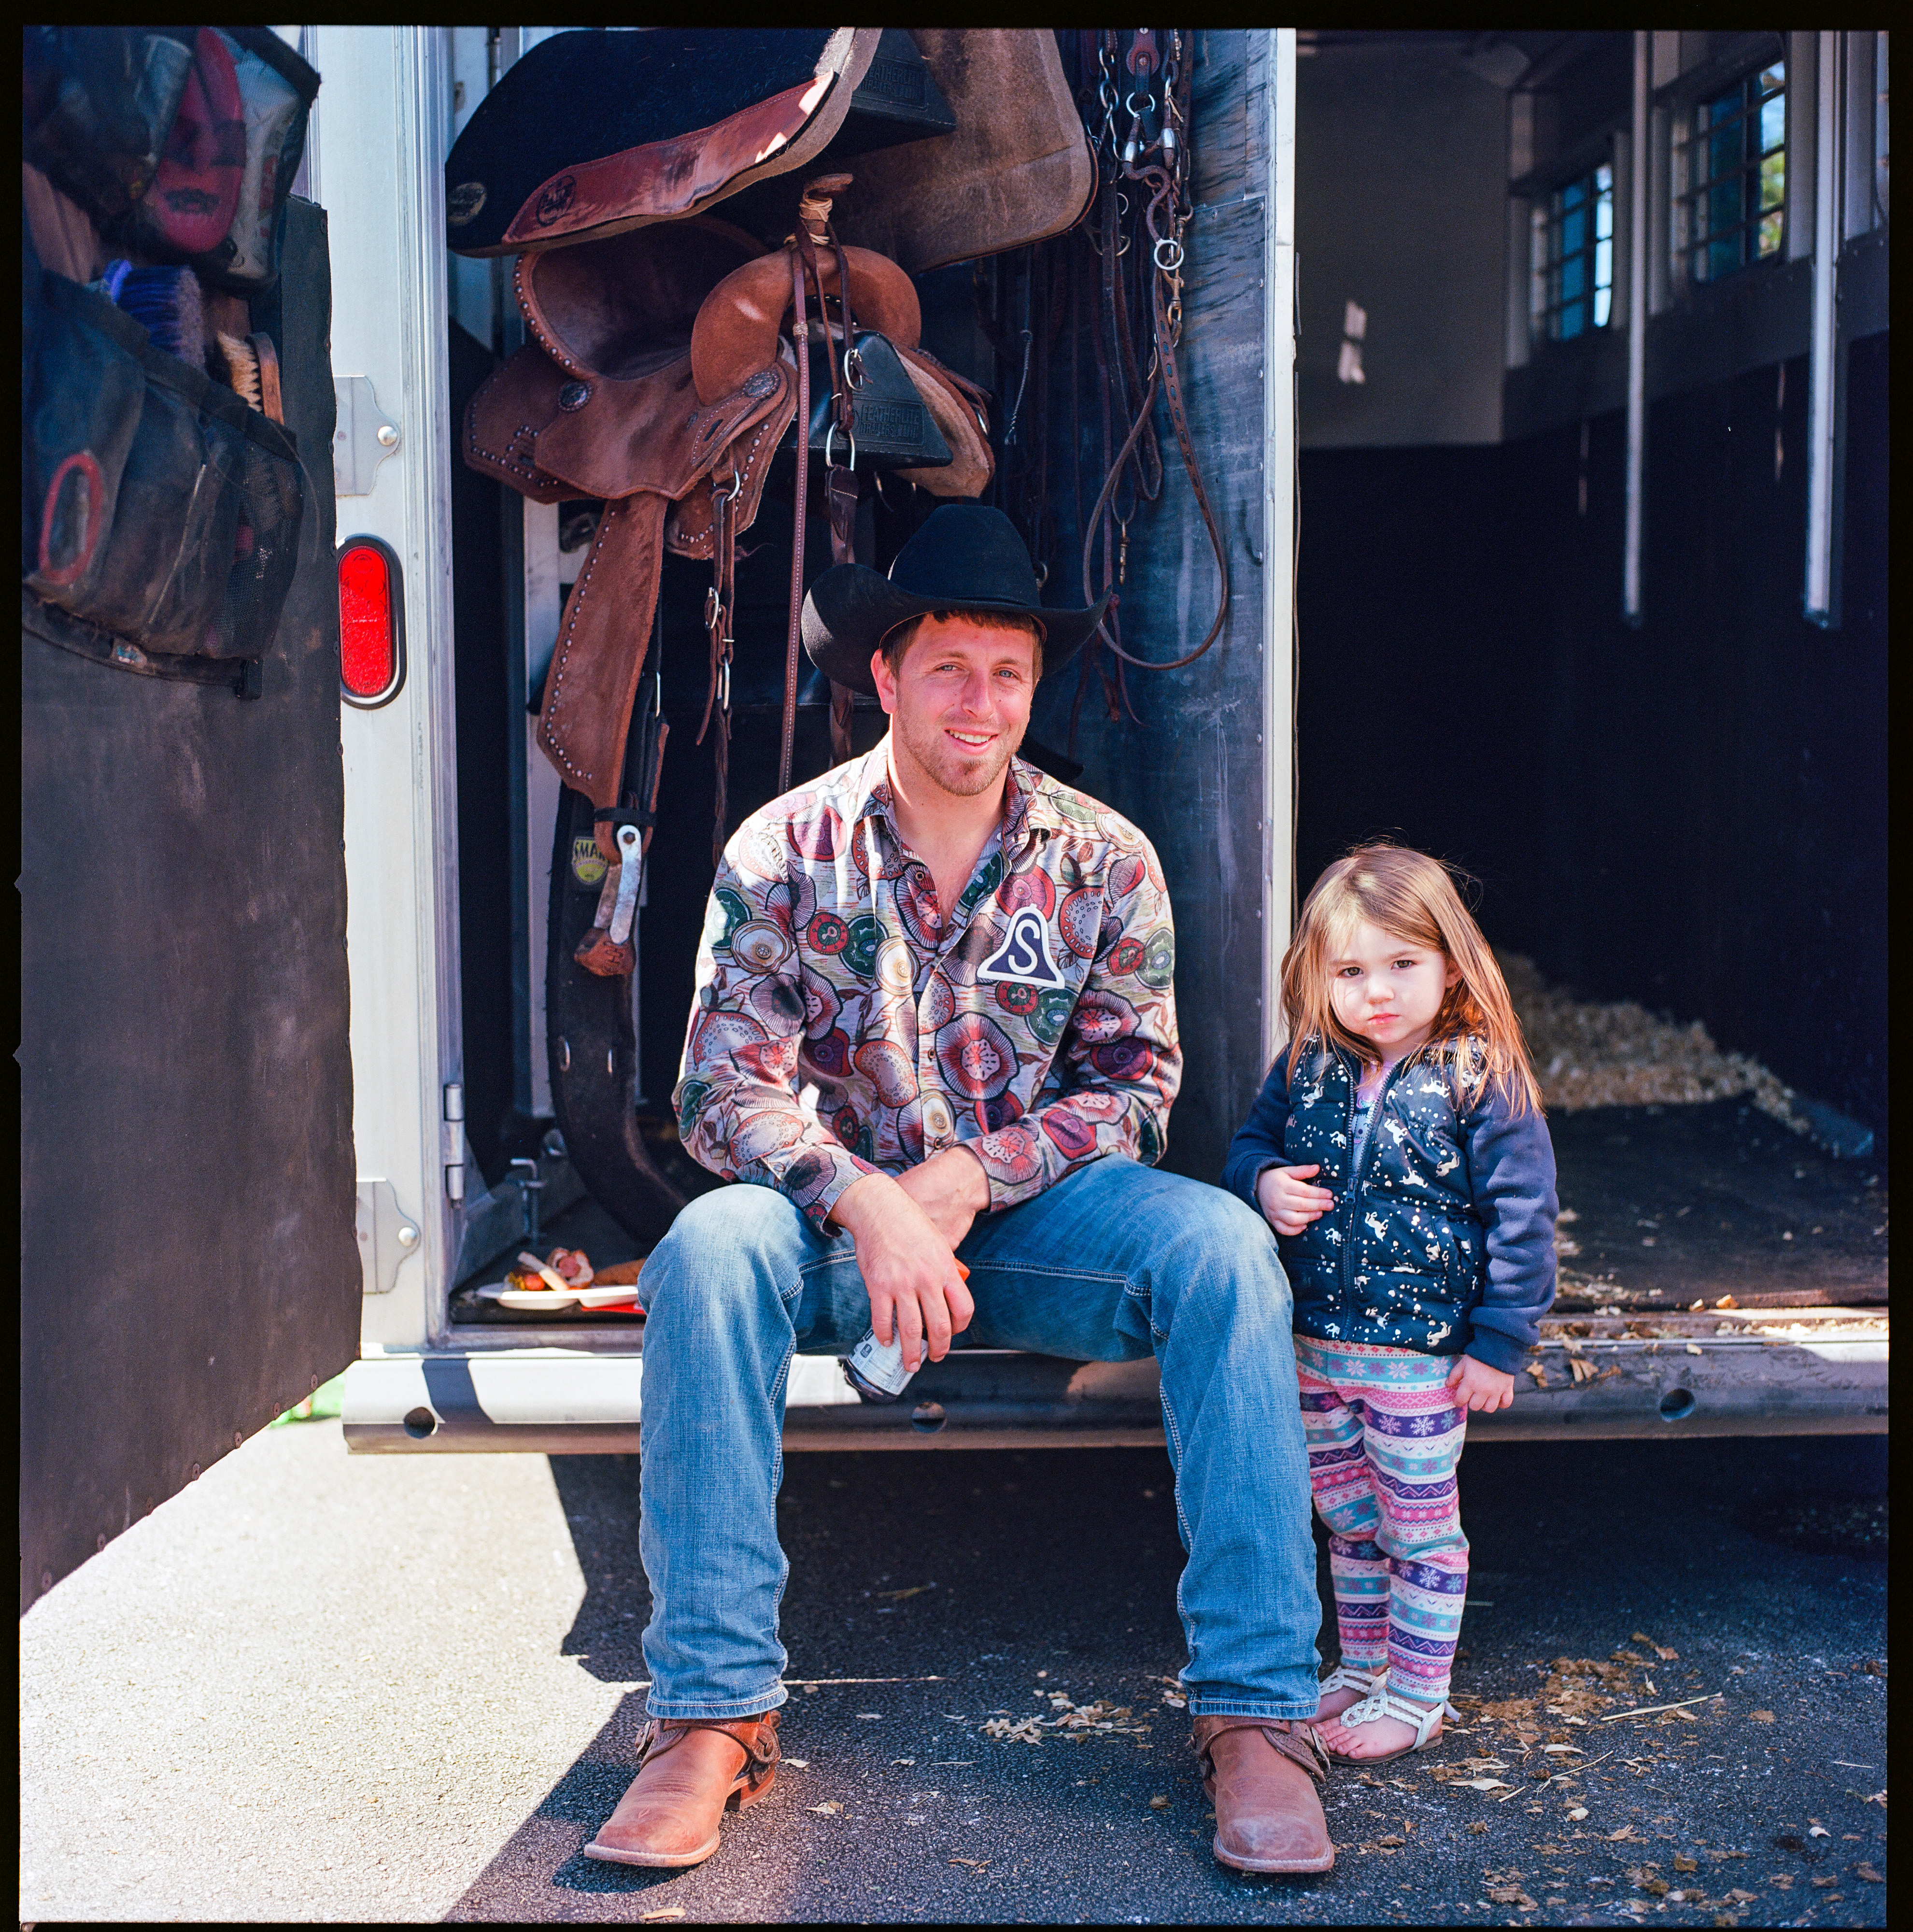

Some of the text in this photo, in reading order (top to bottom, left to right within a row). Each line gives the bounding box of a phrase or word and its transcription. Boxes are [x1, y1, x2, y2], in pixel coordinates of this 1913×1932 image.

[867, 64, 922, 86] EATHERLITE
[861, 405, 920, 425] FEATHERLITE
[1008, 919, 1040, 975] S
